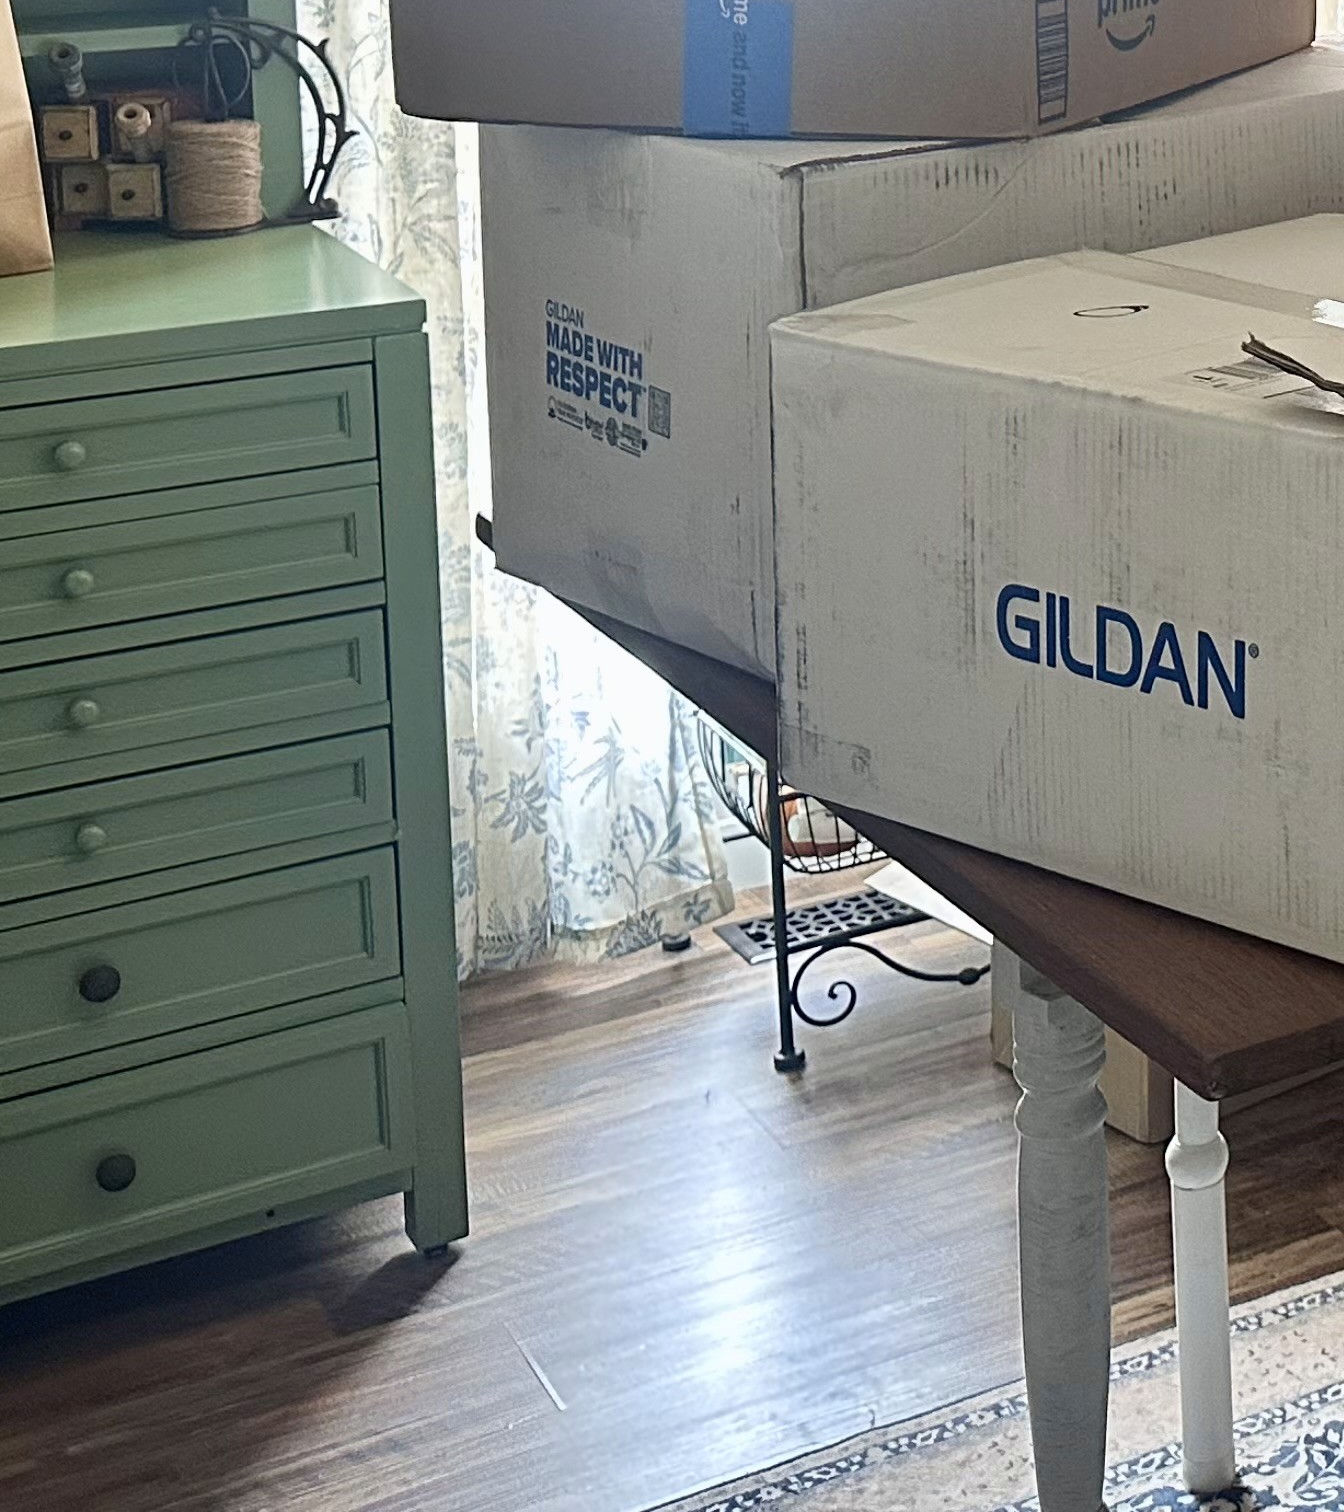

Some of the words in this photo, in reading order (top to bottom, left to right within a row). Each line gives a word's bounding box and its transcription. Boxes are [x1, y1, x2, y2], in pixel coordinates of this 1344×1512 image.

[545, 299, 585, 329] GILDAN
[546, 320, 594, 363] MADE
[596, 338, 643, 381] WITH
